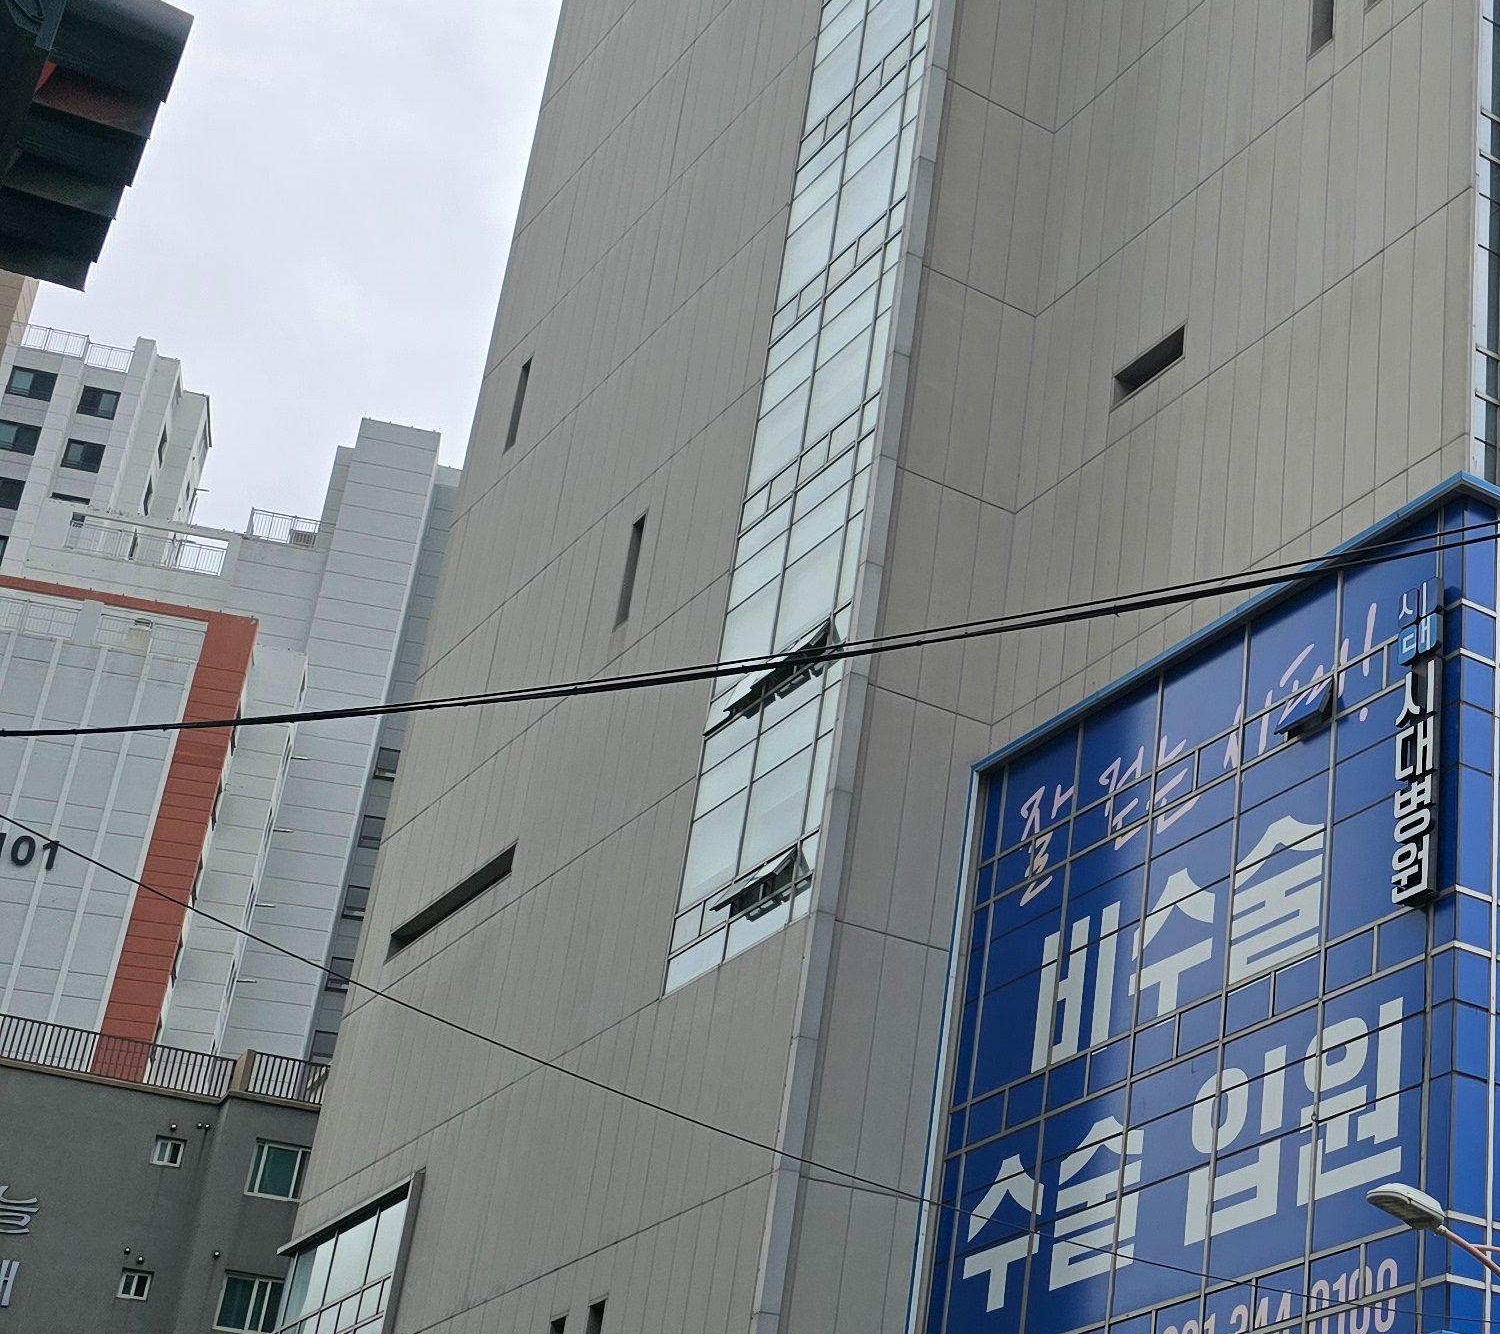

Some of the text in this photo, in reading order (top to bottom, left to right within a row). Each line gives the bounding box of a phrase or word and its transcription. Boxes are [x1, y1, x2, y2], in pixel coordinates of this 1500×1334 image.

[1020, 785, 1074, 907] 잘
[1391, 659, 1436, 905] 시대병원
[1031, 814, 1325, 1075] 비수술
[962, 997, 1402, 1313] 수술 입원
